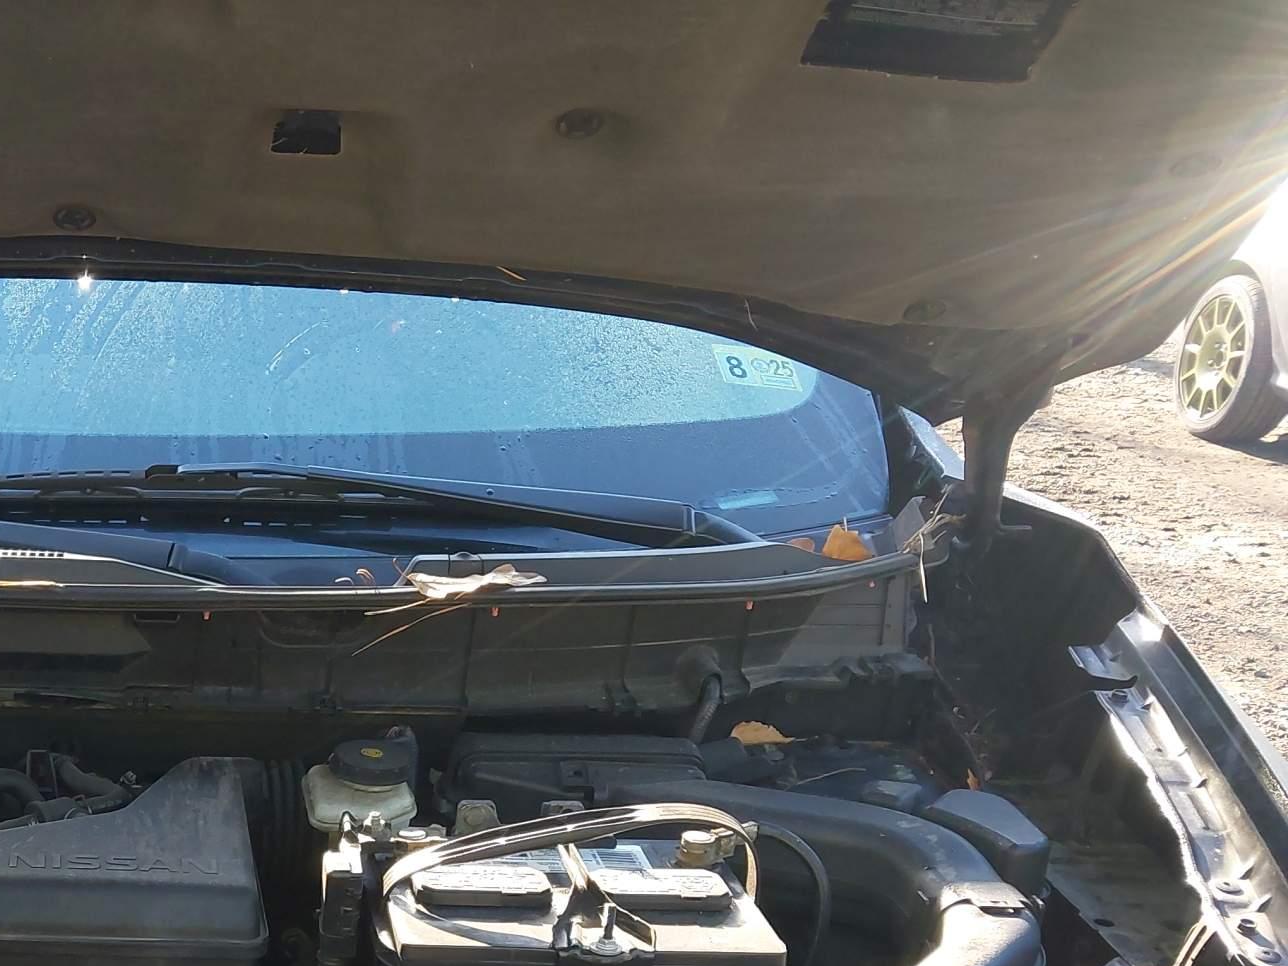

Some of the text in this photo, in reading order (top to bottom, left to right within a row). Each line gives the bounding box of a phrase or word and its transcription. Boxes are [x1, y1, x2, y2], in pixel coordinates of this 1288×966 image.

[726, 355, 794, 378] 8 25
[7, 854, 219, 875] NISSAN
